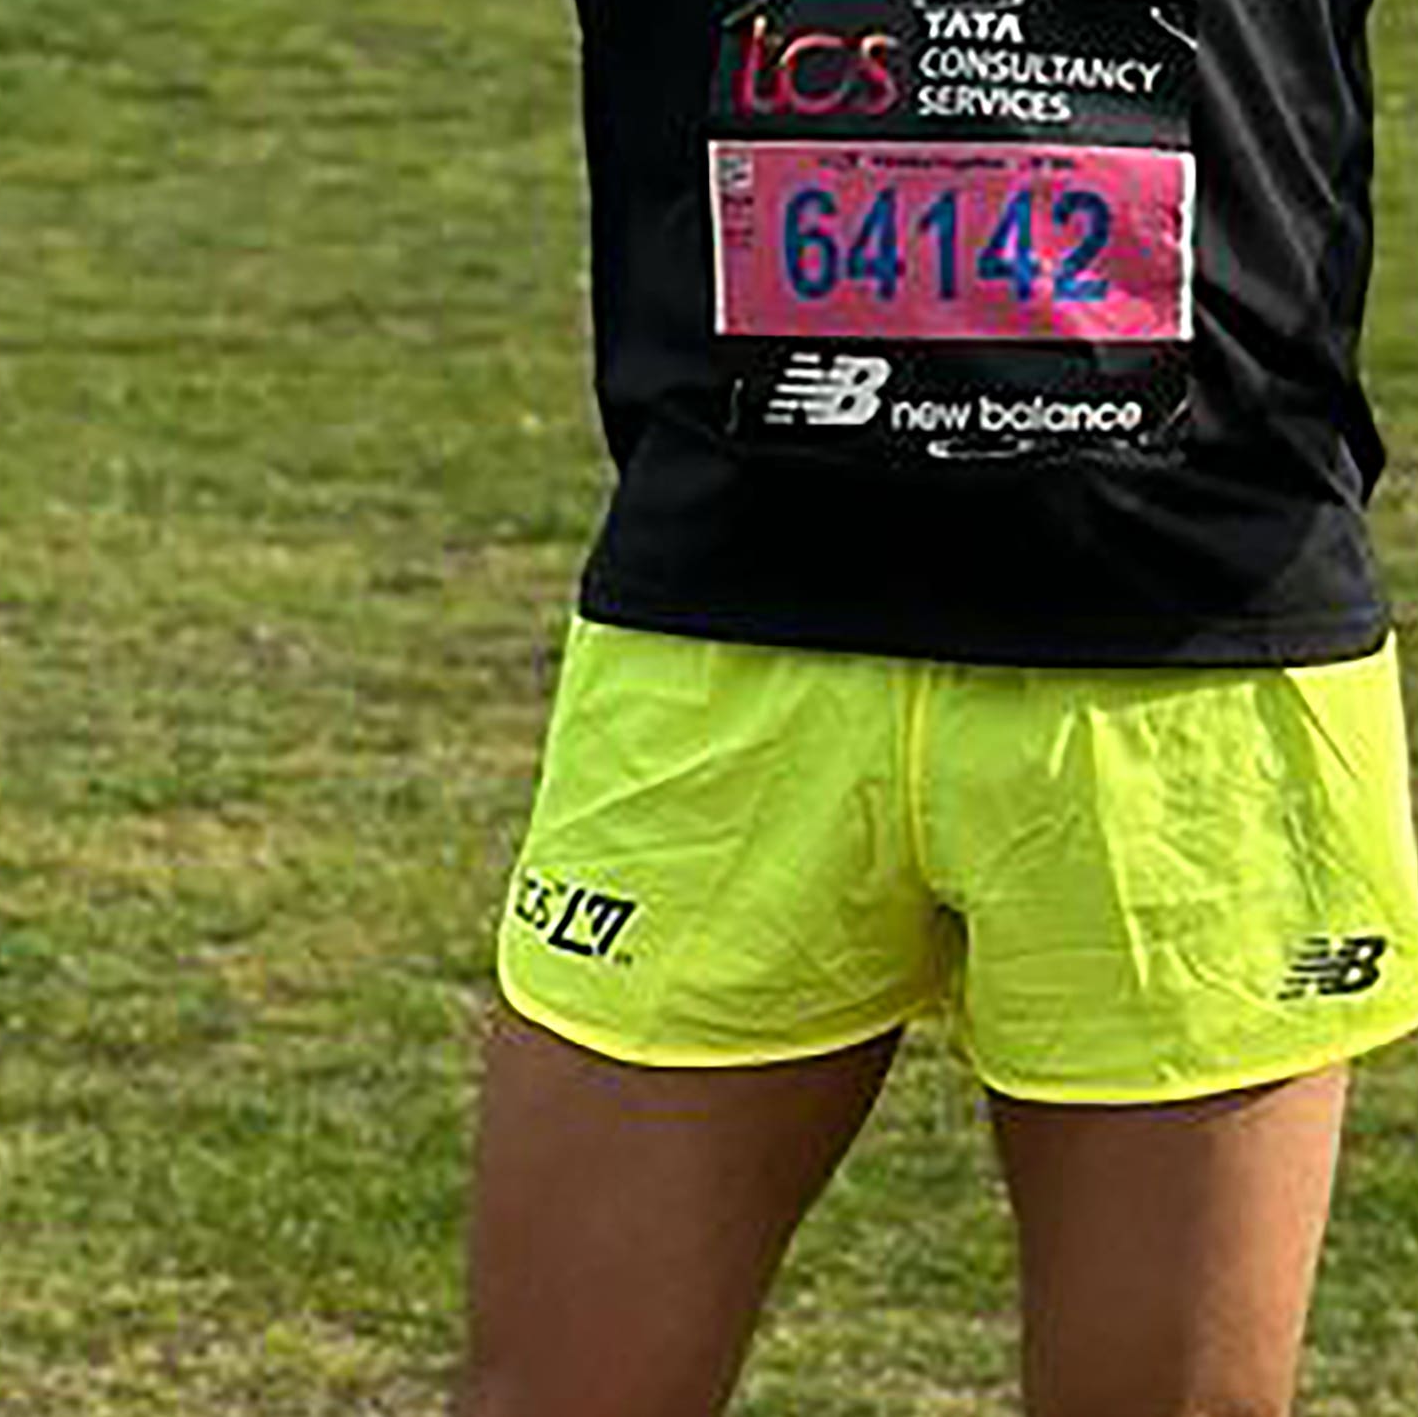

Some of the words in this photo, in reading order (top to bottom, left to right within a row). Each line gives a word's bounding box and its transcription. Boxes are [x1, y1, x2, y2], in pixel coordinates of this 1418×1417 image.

[922, 9, 1024, 44] TATA
[918, 46, 1162, 94] CONSULTANCY
[918, 88, 1072, 122] SERVICES
[782, 186, 1113, 304] 64142
[891, 401, 971, 430] new
[979, 395, 1142, 431] balance
